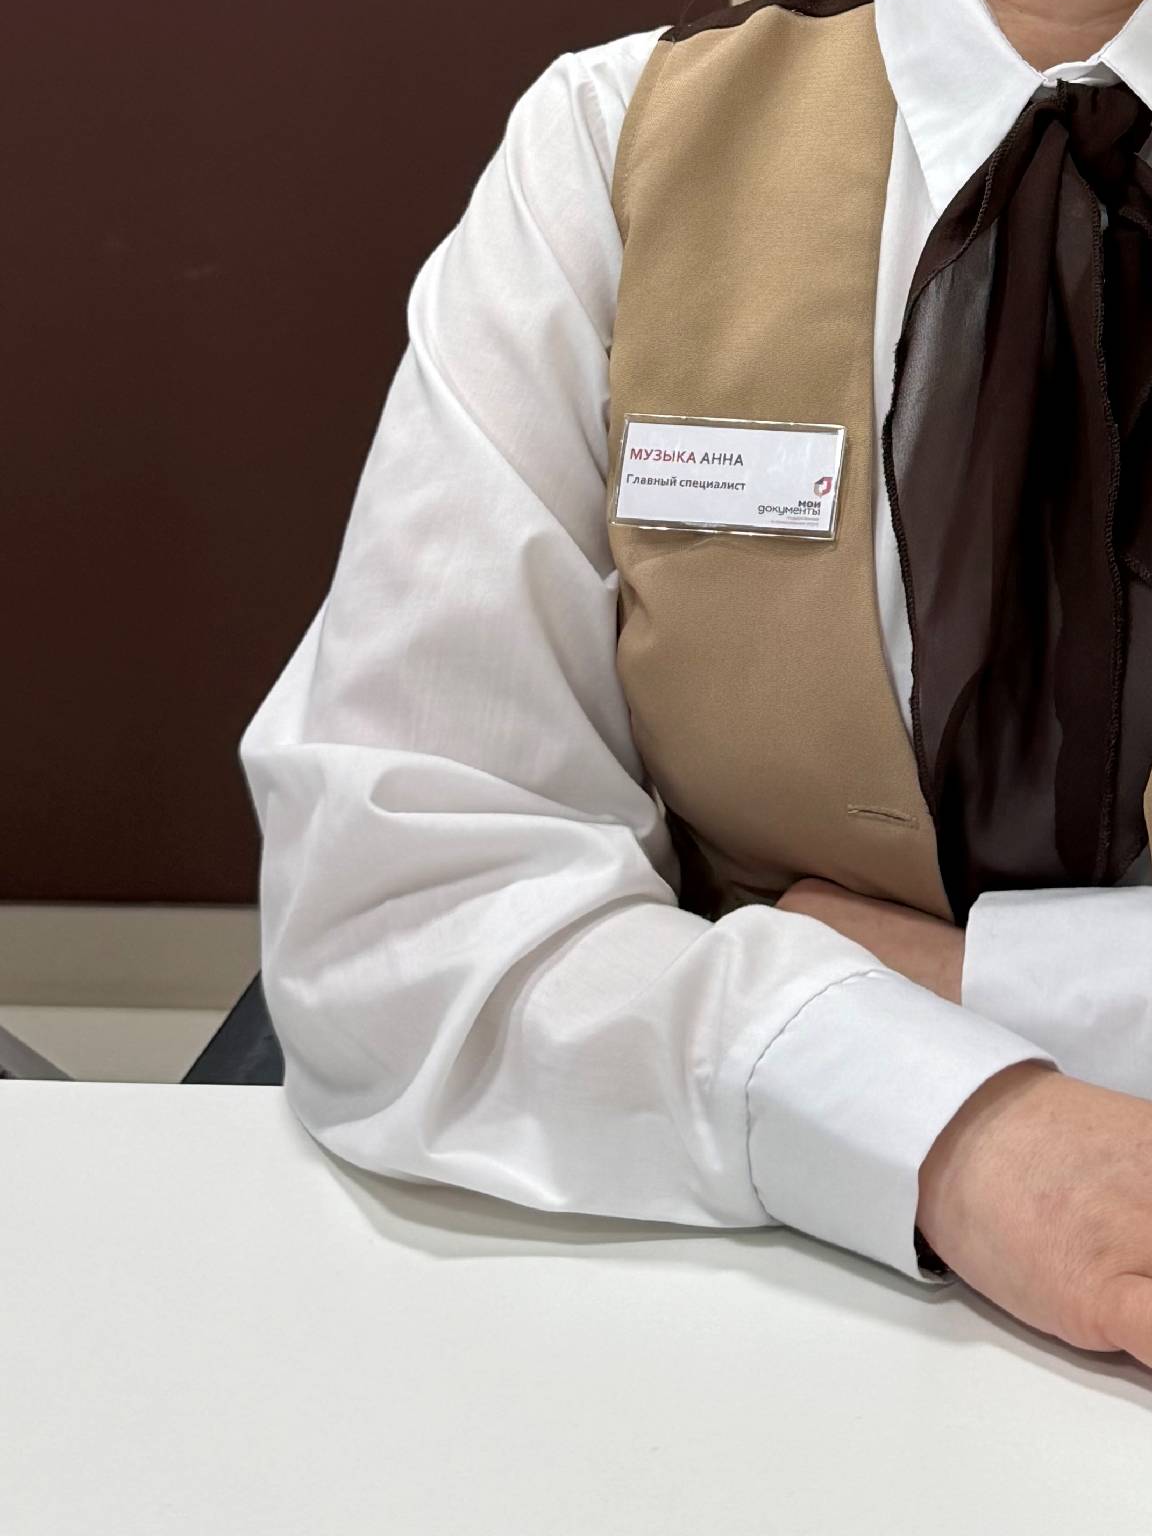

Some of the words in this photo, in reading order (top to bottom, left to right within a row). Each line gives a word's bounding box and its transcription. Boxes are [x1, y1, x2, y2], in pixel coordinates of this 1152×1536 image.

[629, 448, 697, 465] МУЗЫКА
[699, 453, 744, 466] АННА
[626, 474, 678, 488] Главный
[679, 478, 746, 491] специалист
